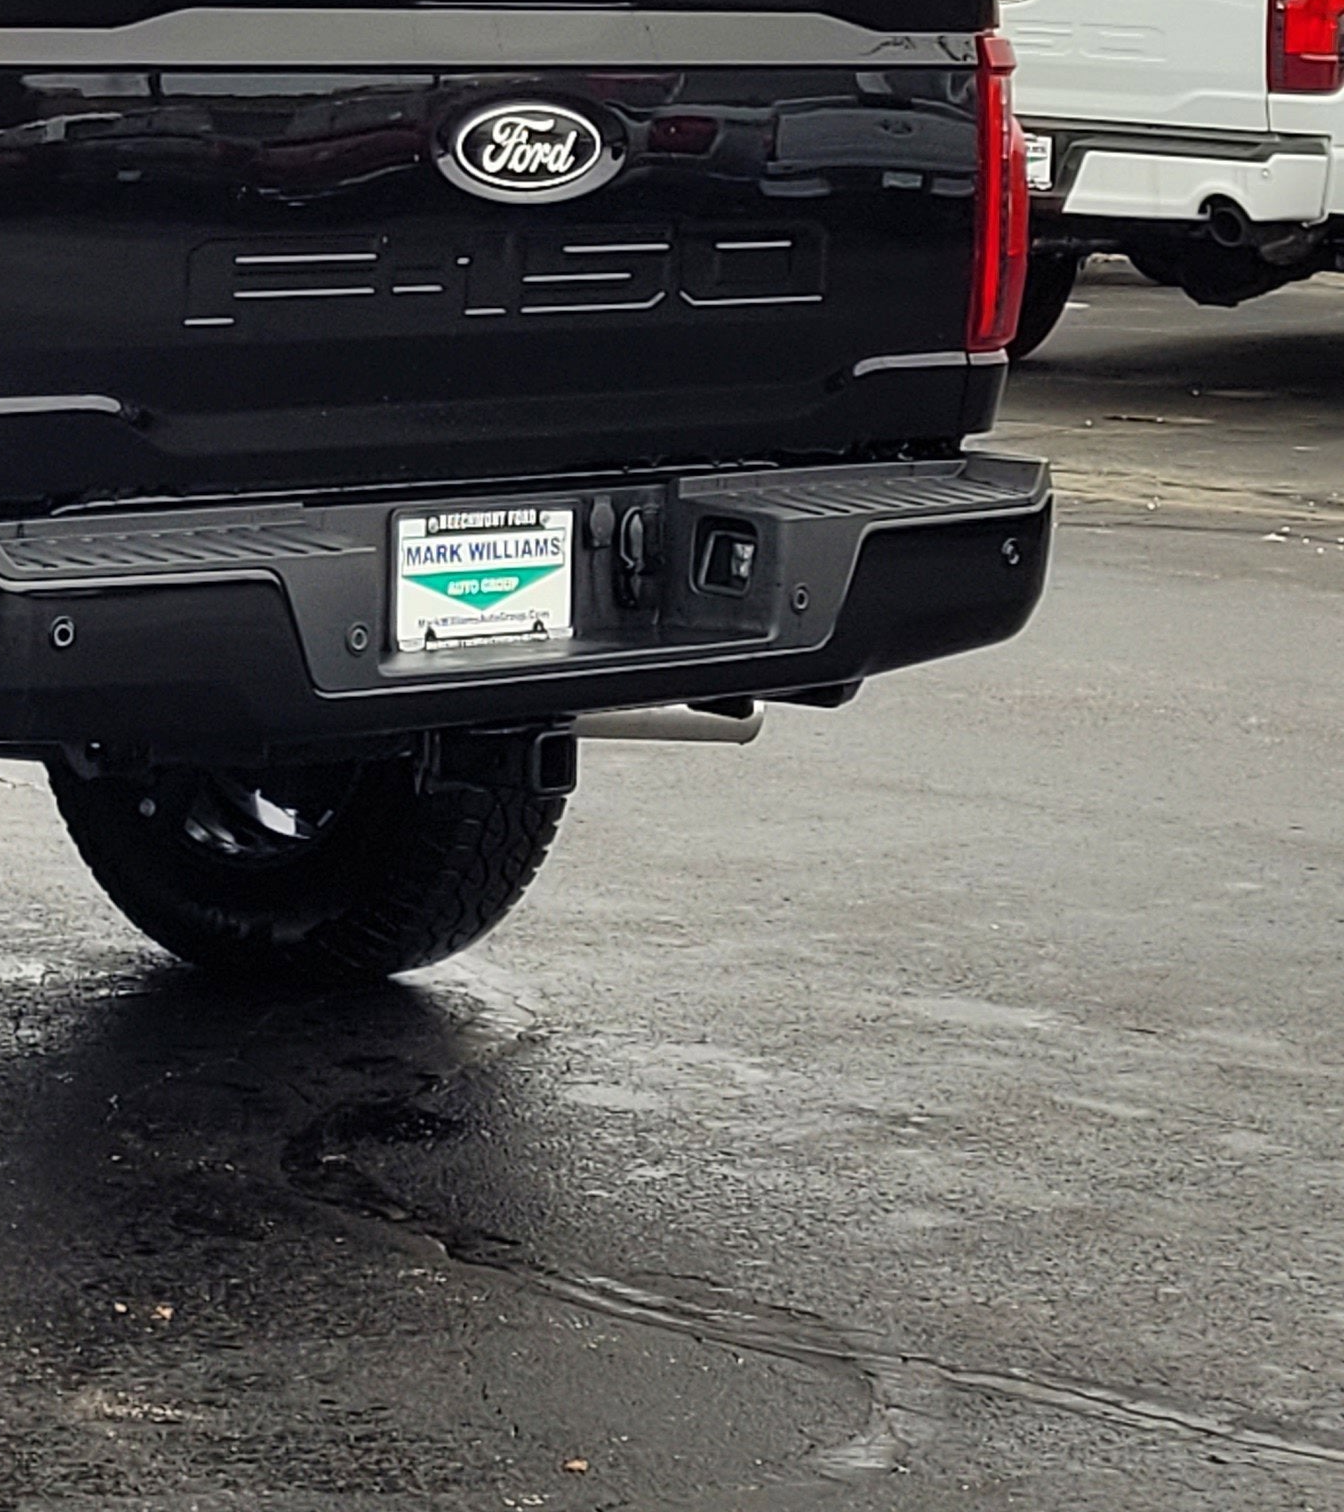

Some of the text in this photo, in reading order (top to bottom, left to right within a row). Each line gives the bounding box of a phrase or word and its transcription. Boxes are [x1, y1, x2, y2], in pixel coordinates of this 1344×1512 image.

[482, 116, 576, 174] Ford
[182, 224, 825, 326] F-150
[406, 537, 562, 567] MARK WILLIAMS
